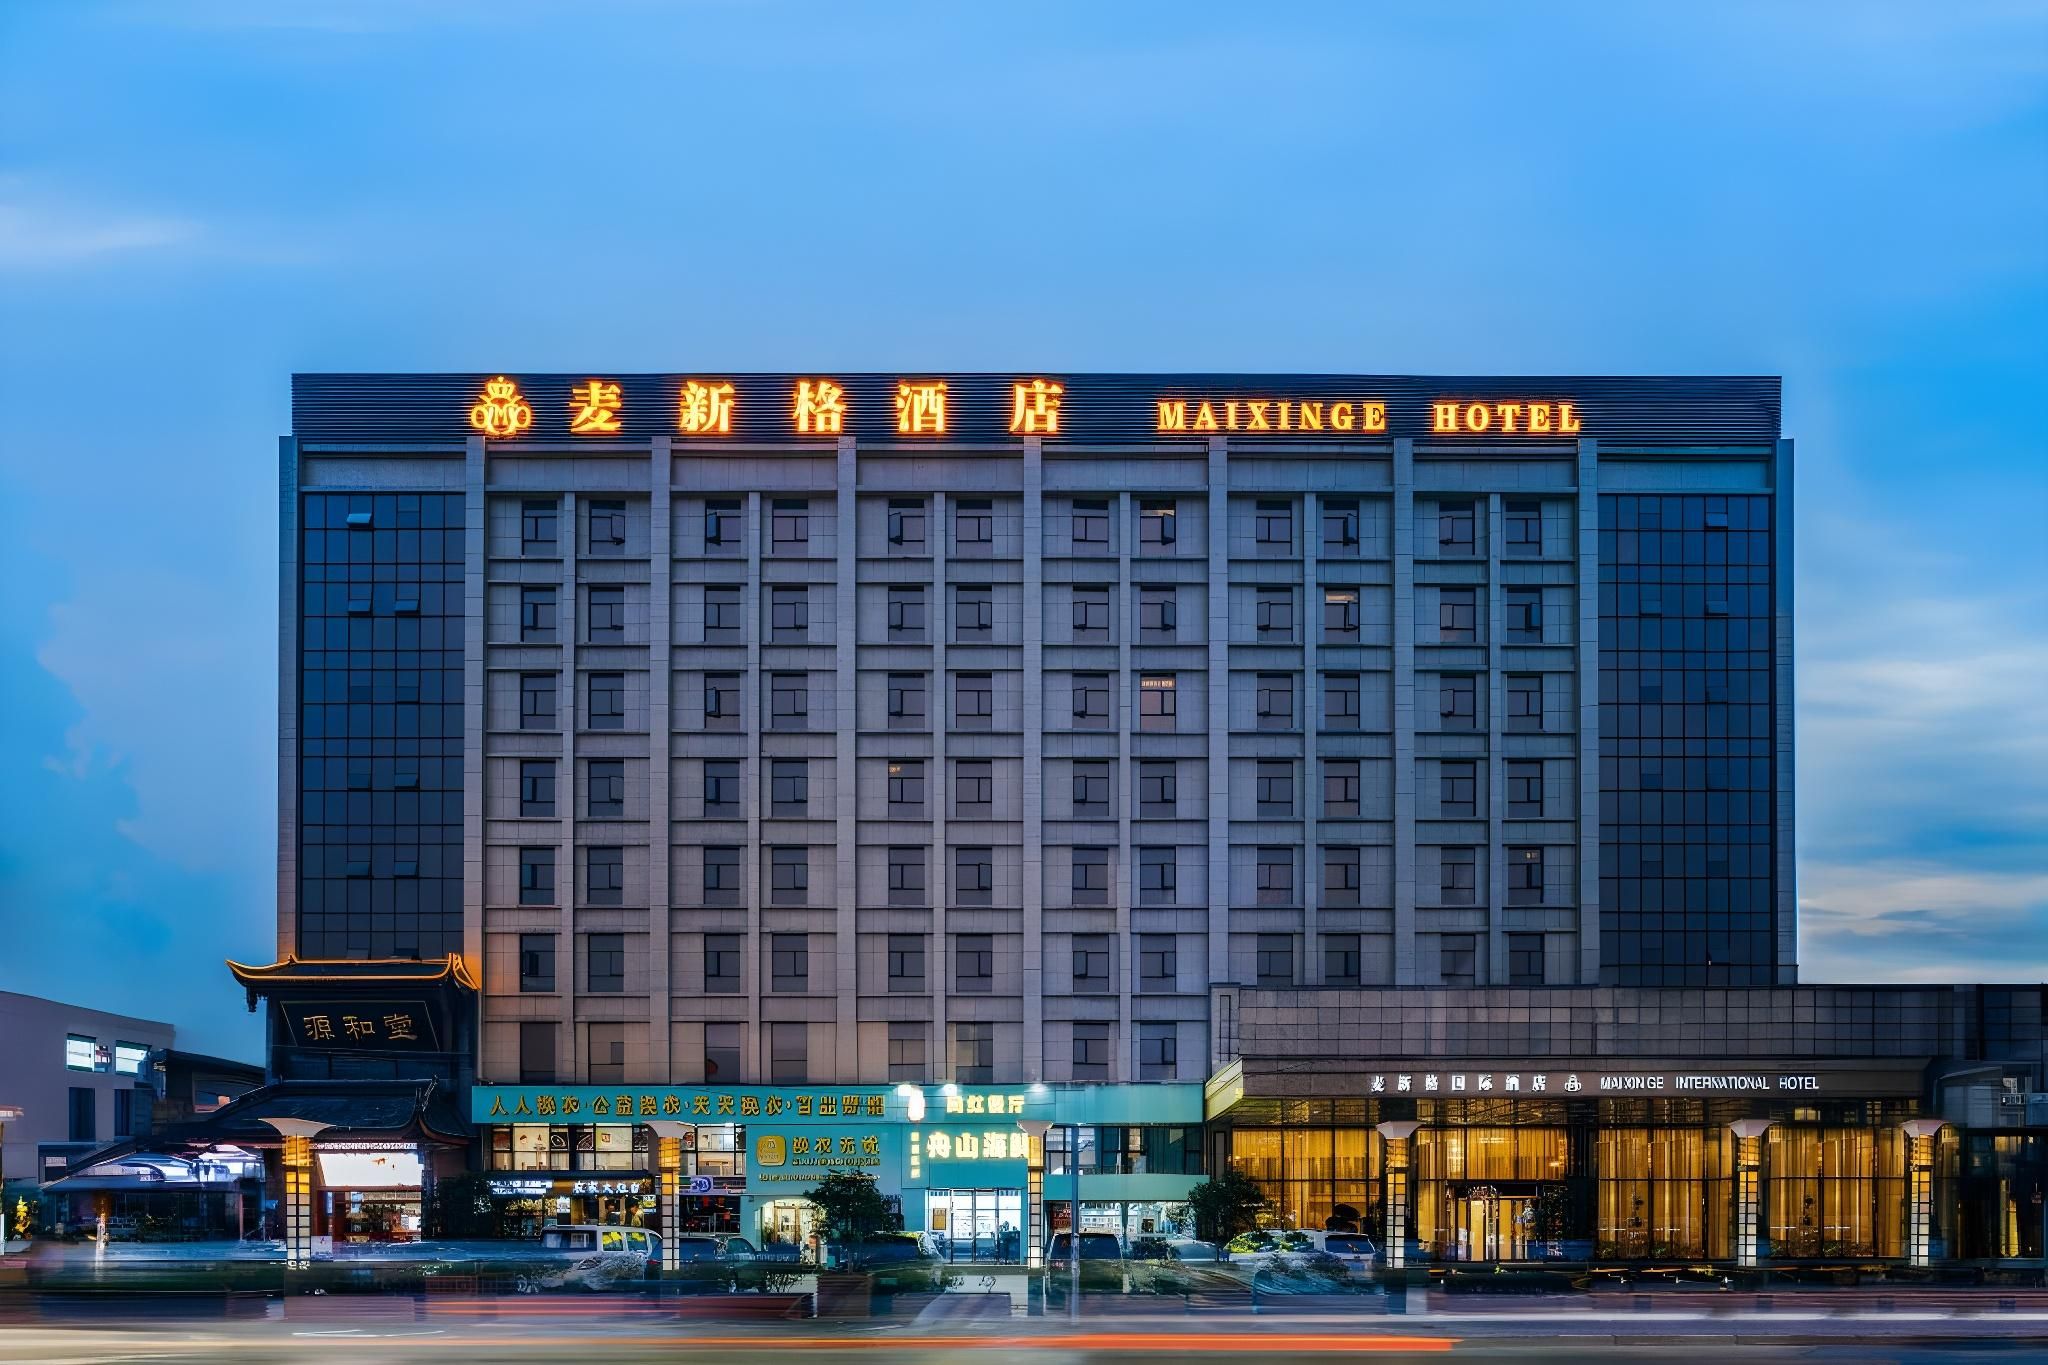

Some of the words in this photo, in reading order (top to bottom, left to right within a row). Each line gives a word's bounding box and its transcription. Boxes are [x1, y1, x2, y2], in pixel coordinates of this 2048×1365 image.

[571, 380, 1064, 434] 麦新格酒店
[1157, 400, 1386, 432] MAIXINGE
[1433, 402, 1580, 432] HOTEL
[1779, 1076, 1819, 1090] HOTEL
